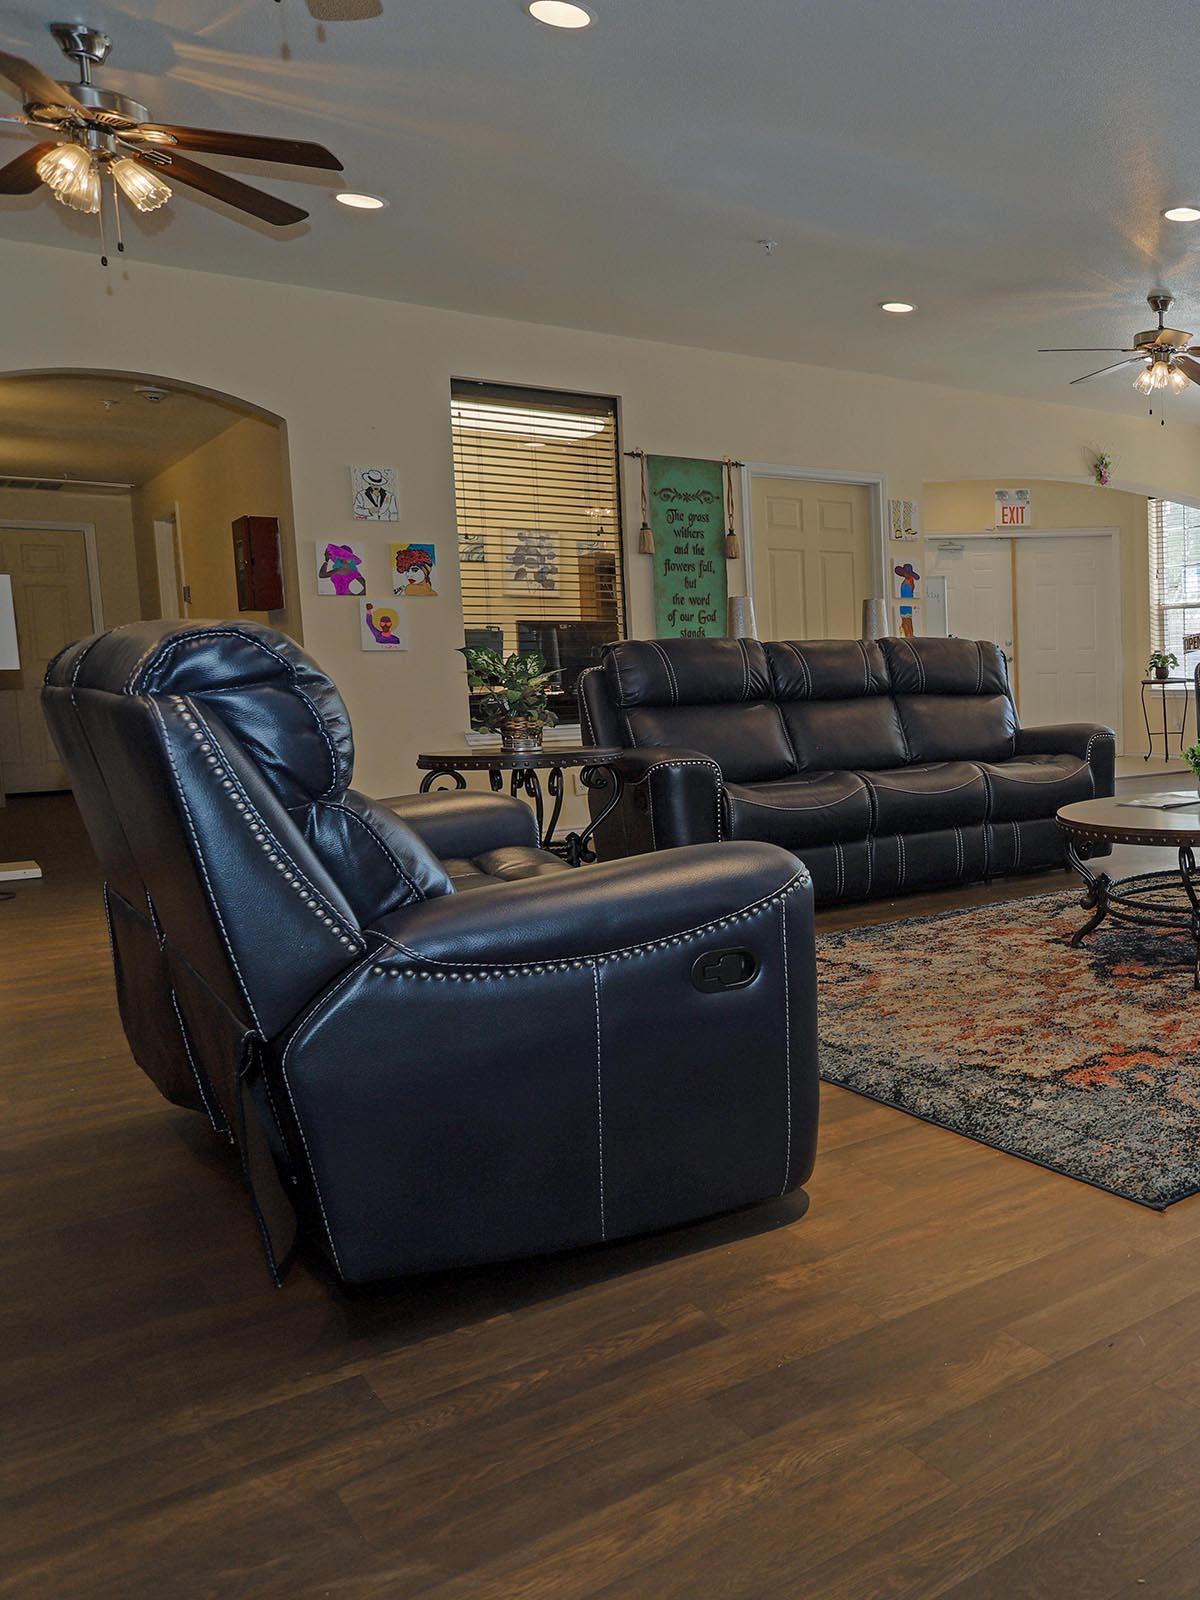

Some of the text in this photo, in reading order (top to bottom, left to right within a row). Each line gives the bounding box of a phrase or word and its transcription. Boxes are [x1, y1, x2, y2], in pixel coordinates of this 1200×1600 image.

[666, 509, 709, 526] The grass
[1002, 506, 1025, 524] EXIT
[673, 526, 705, 539] withers
[674, 543, 705, 555] and the
[664, 559, 696, 576] flowers
[684, 576, 697, 589] but
[672, 593, 711, 606] the word
[668, 609, 717, 627] of our God
